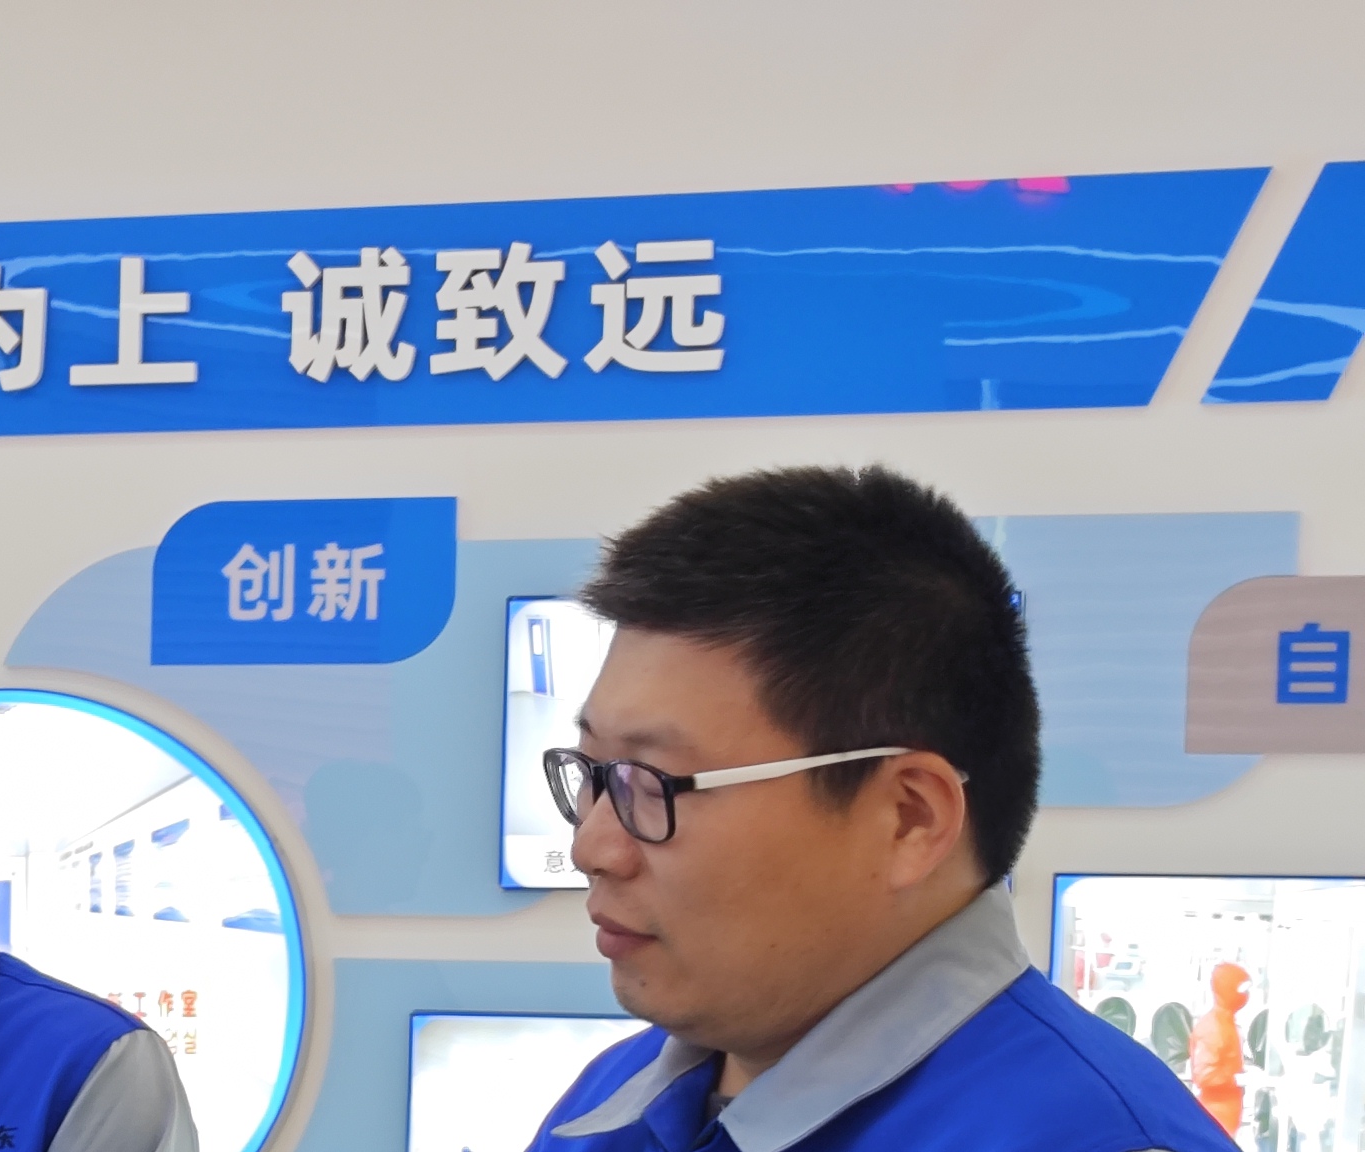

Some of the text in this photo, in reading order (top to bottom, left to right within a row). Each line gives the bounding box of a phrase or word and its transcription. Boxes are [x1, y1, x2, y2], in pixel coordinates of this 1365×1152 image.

[280, 239, 726, 384] 诚致远
[220, 542, 387, 622] 创新
[1276, 622, 1351, 705] 自
